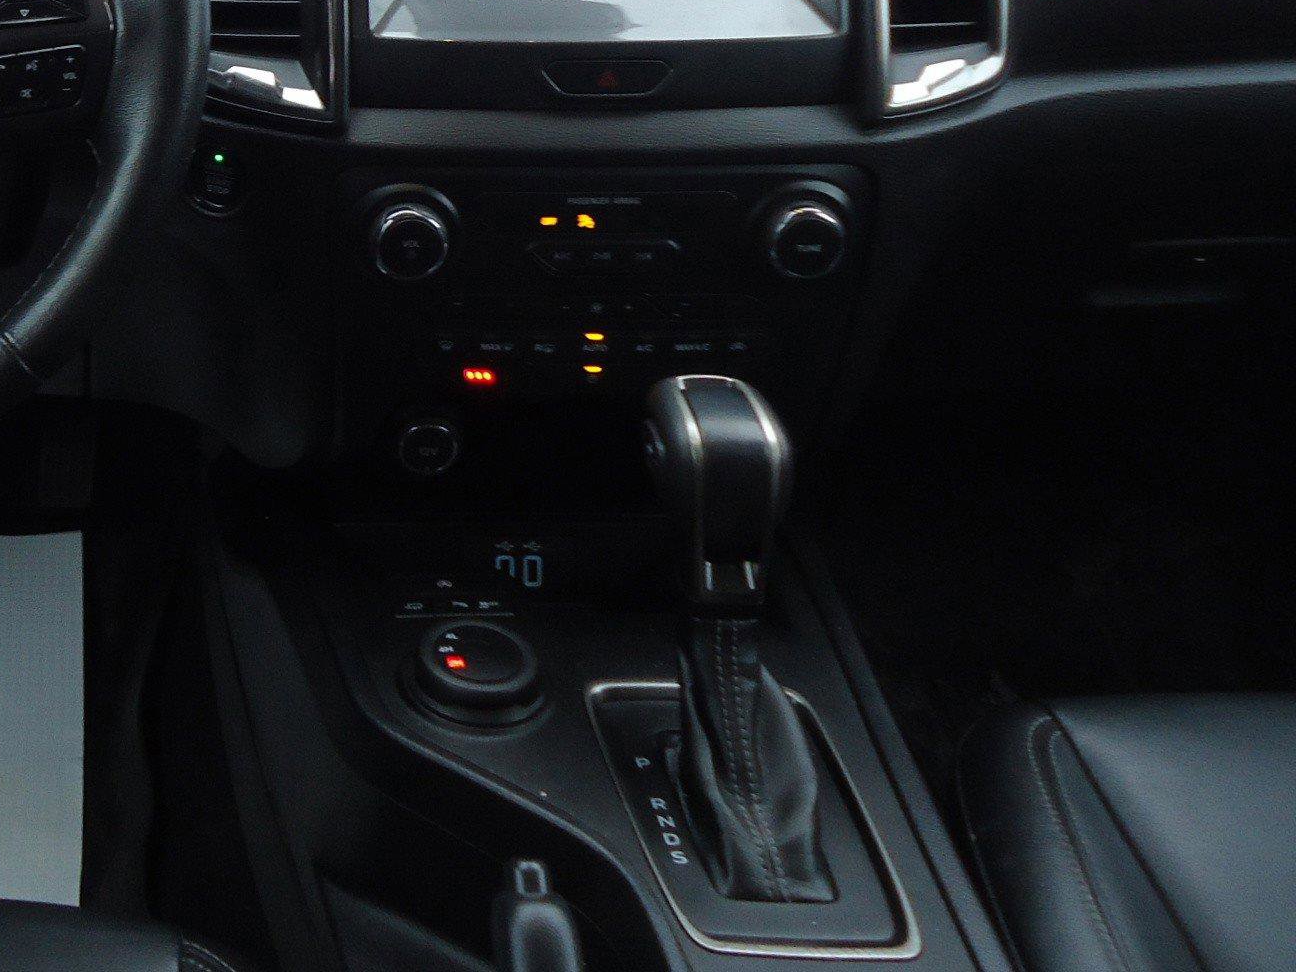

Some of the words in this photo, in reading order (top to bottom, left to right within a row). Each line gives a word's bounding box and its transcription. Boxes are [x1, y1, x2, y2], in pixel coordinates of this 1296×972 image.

[650, 797, 668, 810] R
[656, 815, 676, 828] N
[663, 832, 681, 846] D
[670, 850, 689, 864] S
